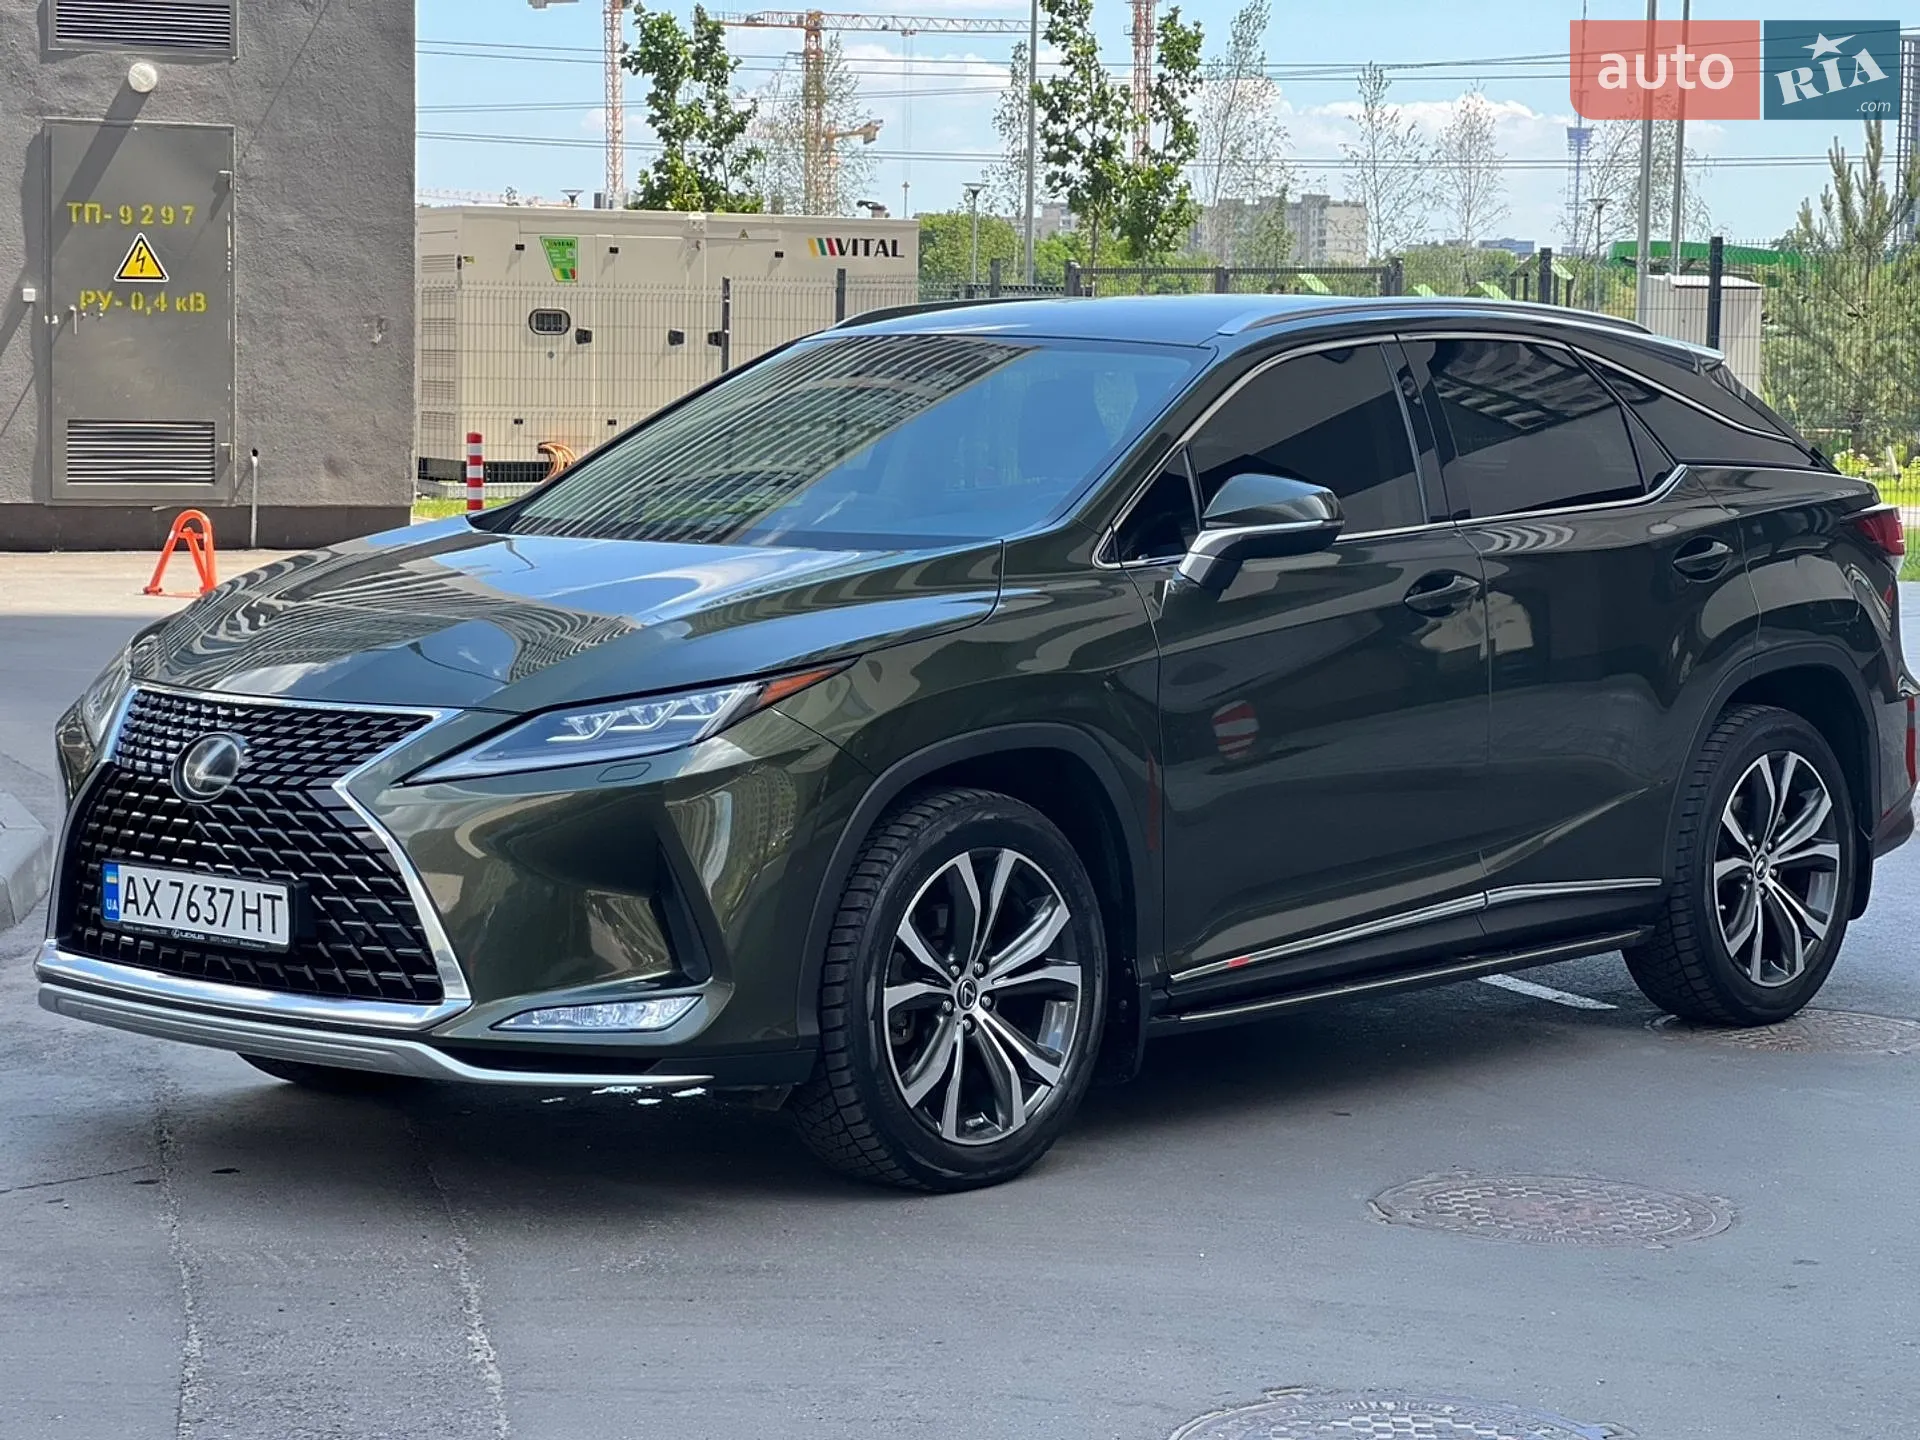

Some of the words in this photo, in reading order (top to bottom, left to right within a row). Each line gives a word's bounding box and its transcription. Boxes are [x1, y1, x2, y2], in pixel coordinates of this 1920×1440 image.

[835, 237, 905, 258] VITAL
[106, 898, 119, 911] UA
[122, 875, 162, 918] AX
[168, 881, 235, 928] 7637
[241, 890, 283, 934] HT
